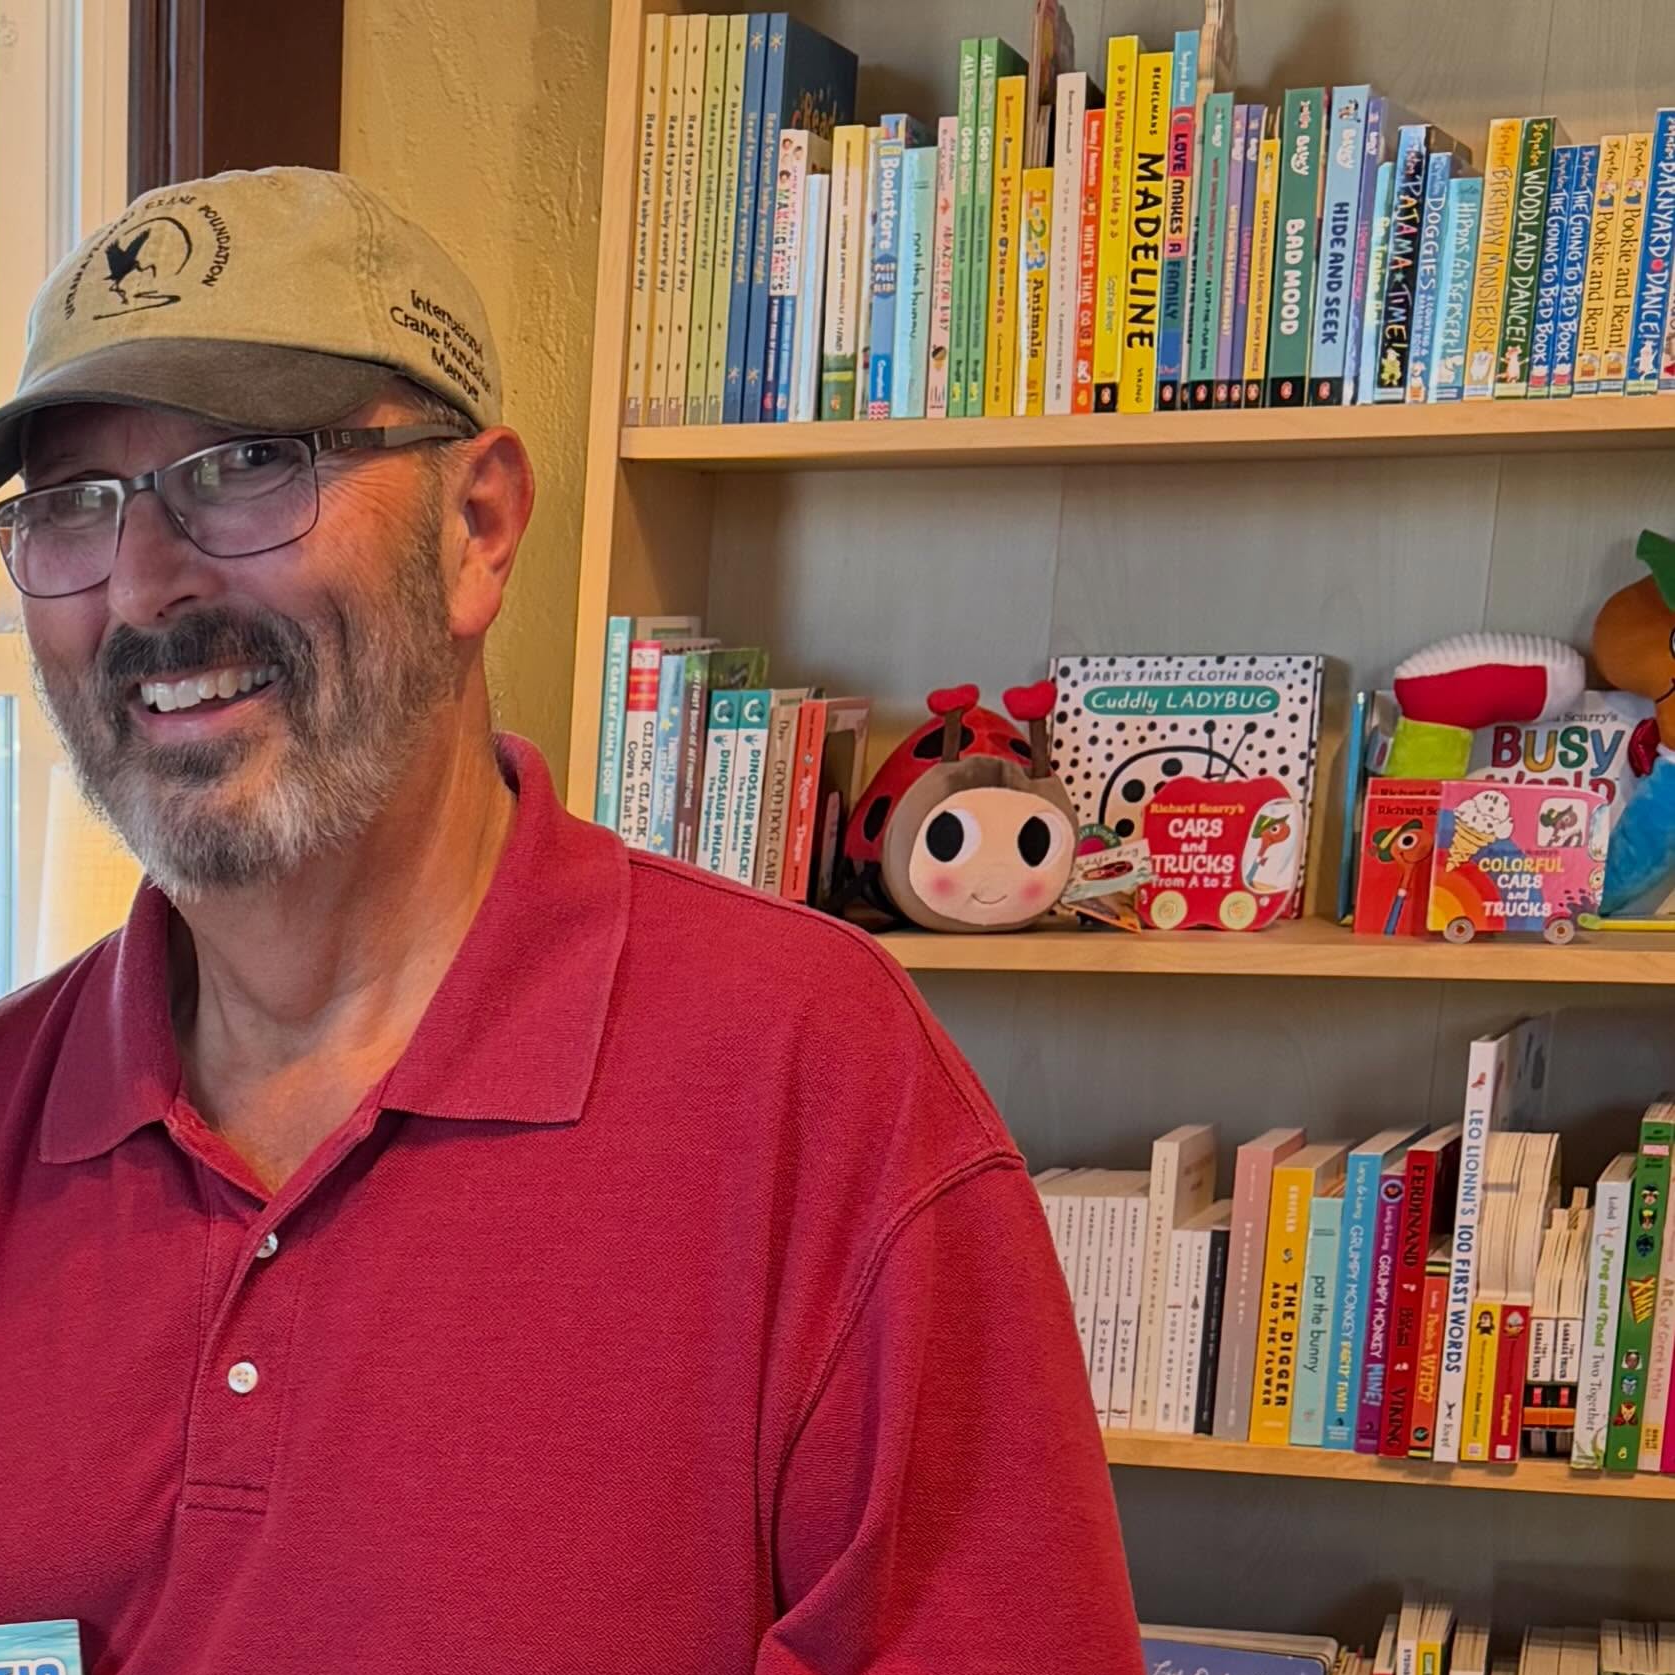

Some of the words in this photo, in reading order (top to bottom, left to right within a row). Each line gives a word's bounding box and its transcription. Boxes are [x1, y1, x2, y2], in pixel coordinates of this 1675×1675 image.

[1175, 132, 1188, 172] LOVE
[875, 155, 900, 250] Bookstore
[1170, 179, 1184, 235] MAKES
[1513, 168, 1546, 272] WOODLAND
[1547, 189, 1568, 215] THE
[1570, 187, 1592, 213] THE
[1285, 219, 1306, 265] BAD
[1328, 202, 1349, 250] HIDE
[1417, 197, 1445, 291] DOGGIES
[1542, 216, 1566, 264] GOING
[1565, 214, 1590, 262] GOING
[1588, 210, 1613, 267] Pookie
[1616, 207, 1641, 264] Pookie
[1127, 152, 1165, 349] MADELINE
[1541, 264, 1559, 283] TO
[1564, 262, 1582, 281] TO
[1165, 261, 1181, 321] FAMILY
[1325, 252, 1345, 296] AND
[1586, 271, 1606, 304] and
[1613, 267, 1634, 301] and
[1024, 279, 1046, 360] Animals
[1280, 269, 1303, 335] MOOD
[1320, 298, 1341, 347] SEEK
[1506, 277, 1535, 343] DANCE!
[1538, 282, 1559, 320] BED
[1558, 281, 1581, 318] BED
[1639, 272, 1667, 346] DANCE!
[389, 306, 440, 344] Crane
[1530, 324, 1554, 366] BOOK
[1553, 321, 1576, 365] BOOK
[1580, 306, 1602, 353] Bean!
[1606, 303, 1630, 350] Bean!
[1082, 670, 1132, 682] BABY'S
[1139, 670, 1181, 681] FIRST
[1188, 670, 1238, 681] CLOTH
[1244, 670, 1286, 681] BOOK
[1091, 691, 1158, 713] Cuddly
[1165, 691, 1273, 709] LADYBUG
[1490, 724, 1625, 777] BUSY
[714, 750, 731, 821] DINOSAUR
[742, 749, 761, 822] DINOSAUR
[1168, 818, 1223, 838] CARS
[1181, 840, 1207, 854] and
[1151, 855, 1235, 875] TRUCKS
[1478, 857, 1564, 873] COLORFUL
[1497, 874, 1543, 889] CARS
[1482, 901, 1552, 917] TRUCKS
[1468, 1109, 1483, 1140] LEO
[1460, 1145, 1481, 1216] LIONNI'S
[1399, 1162, 1426, 1269] FERDINAND
[1457, 1224, 1474, 1254] 100
[1283, 1282, 1297, 1321] THE
[1451, 1259, 1470, 1305] FIRST
[1302, 1330, 1327, 1374] bunny
[1445, 1310, 1465, 1374] WORDS
[1262, 1350, 1276, 1406] FLOWER
[1275, 1330, 1294, 1407] DIGGER
